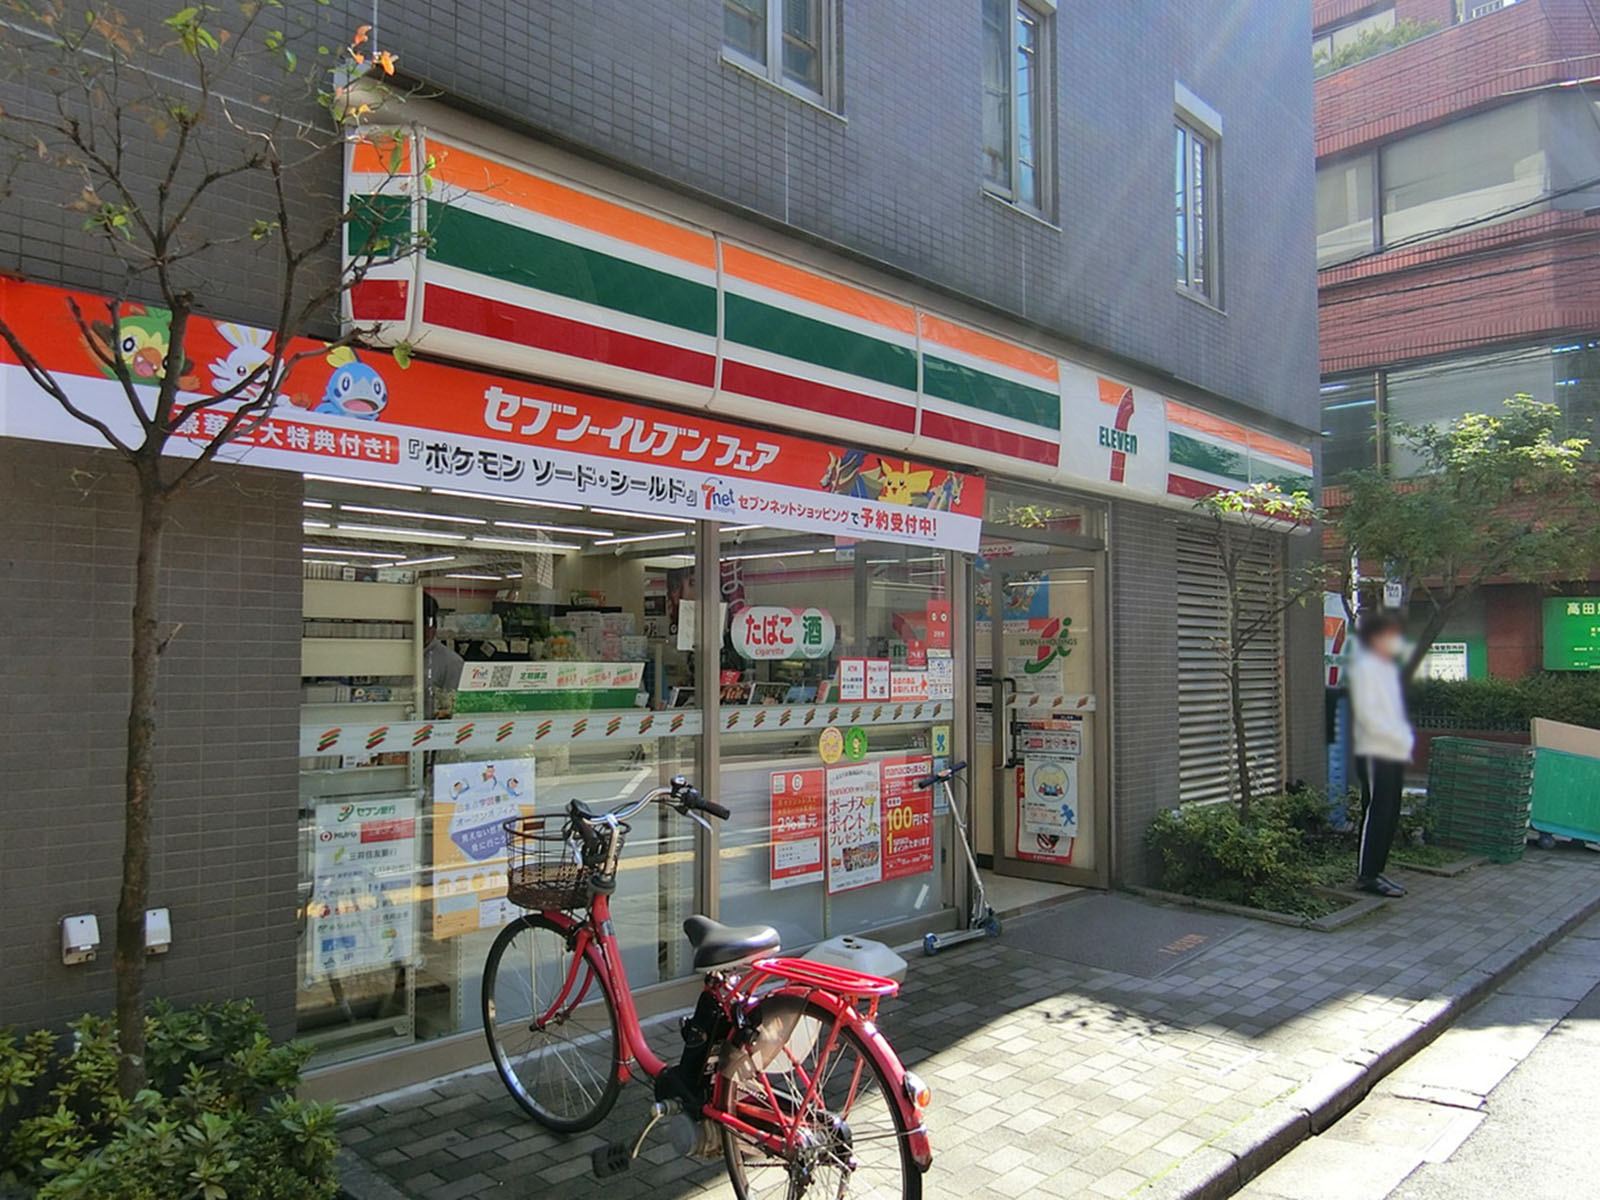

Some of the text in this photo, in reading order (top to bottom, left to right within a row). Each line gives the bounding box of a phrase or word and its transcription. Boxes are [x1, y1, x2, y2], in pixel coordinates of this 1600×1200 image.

[714, 435, 780, 472] フェア
[1567, 602, 1600, 615] 高田
[745, 614, 822, 646] たばこ 酒
[829, 795, 866, 816] ボーナス
[829, 812, 866, 834] ポイント
[830, 831, 865, 848] プレゼント
